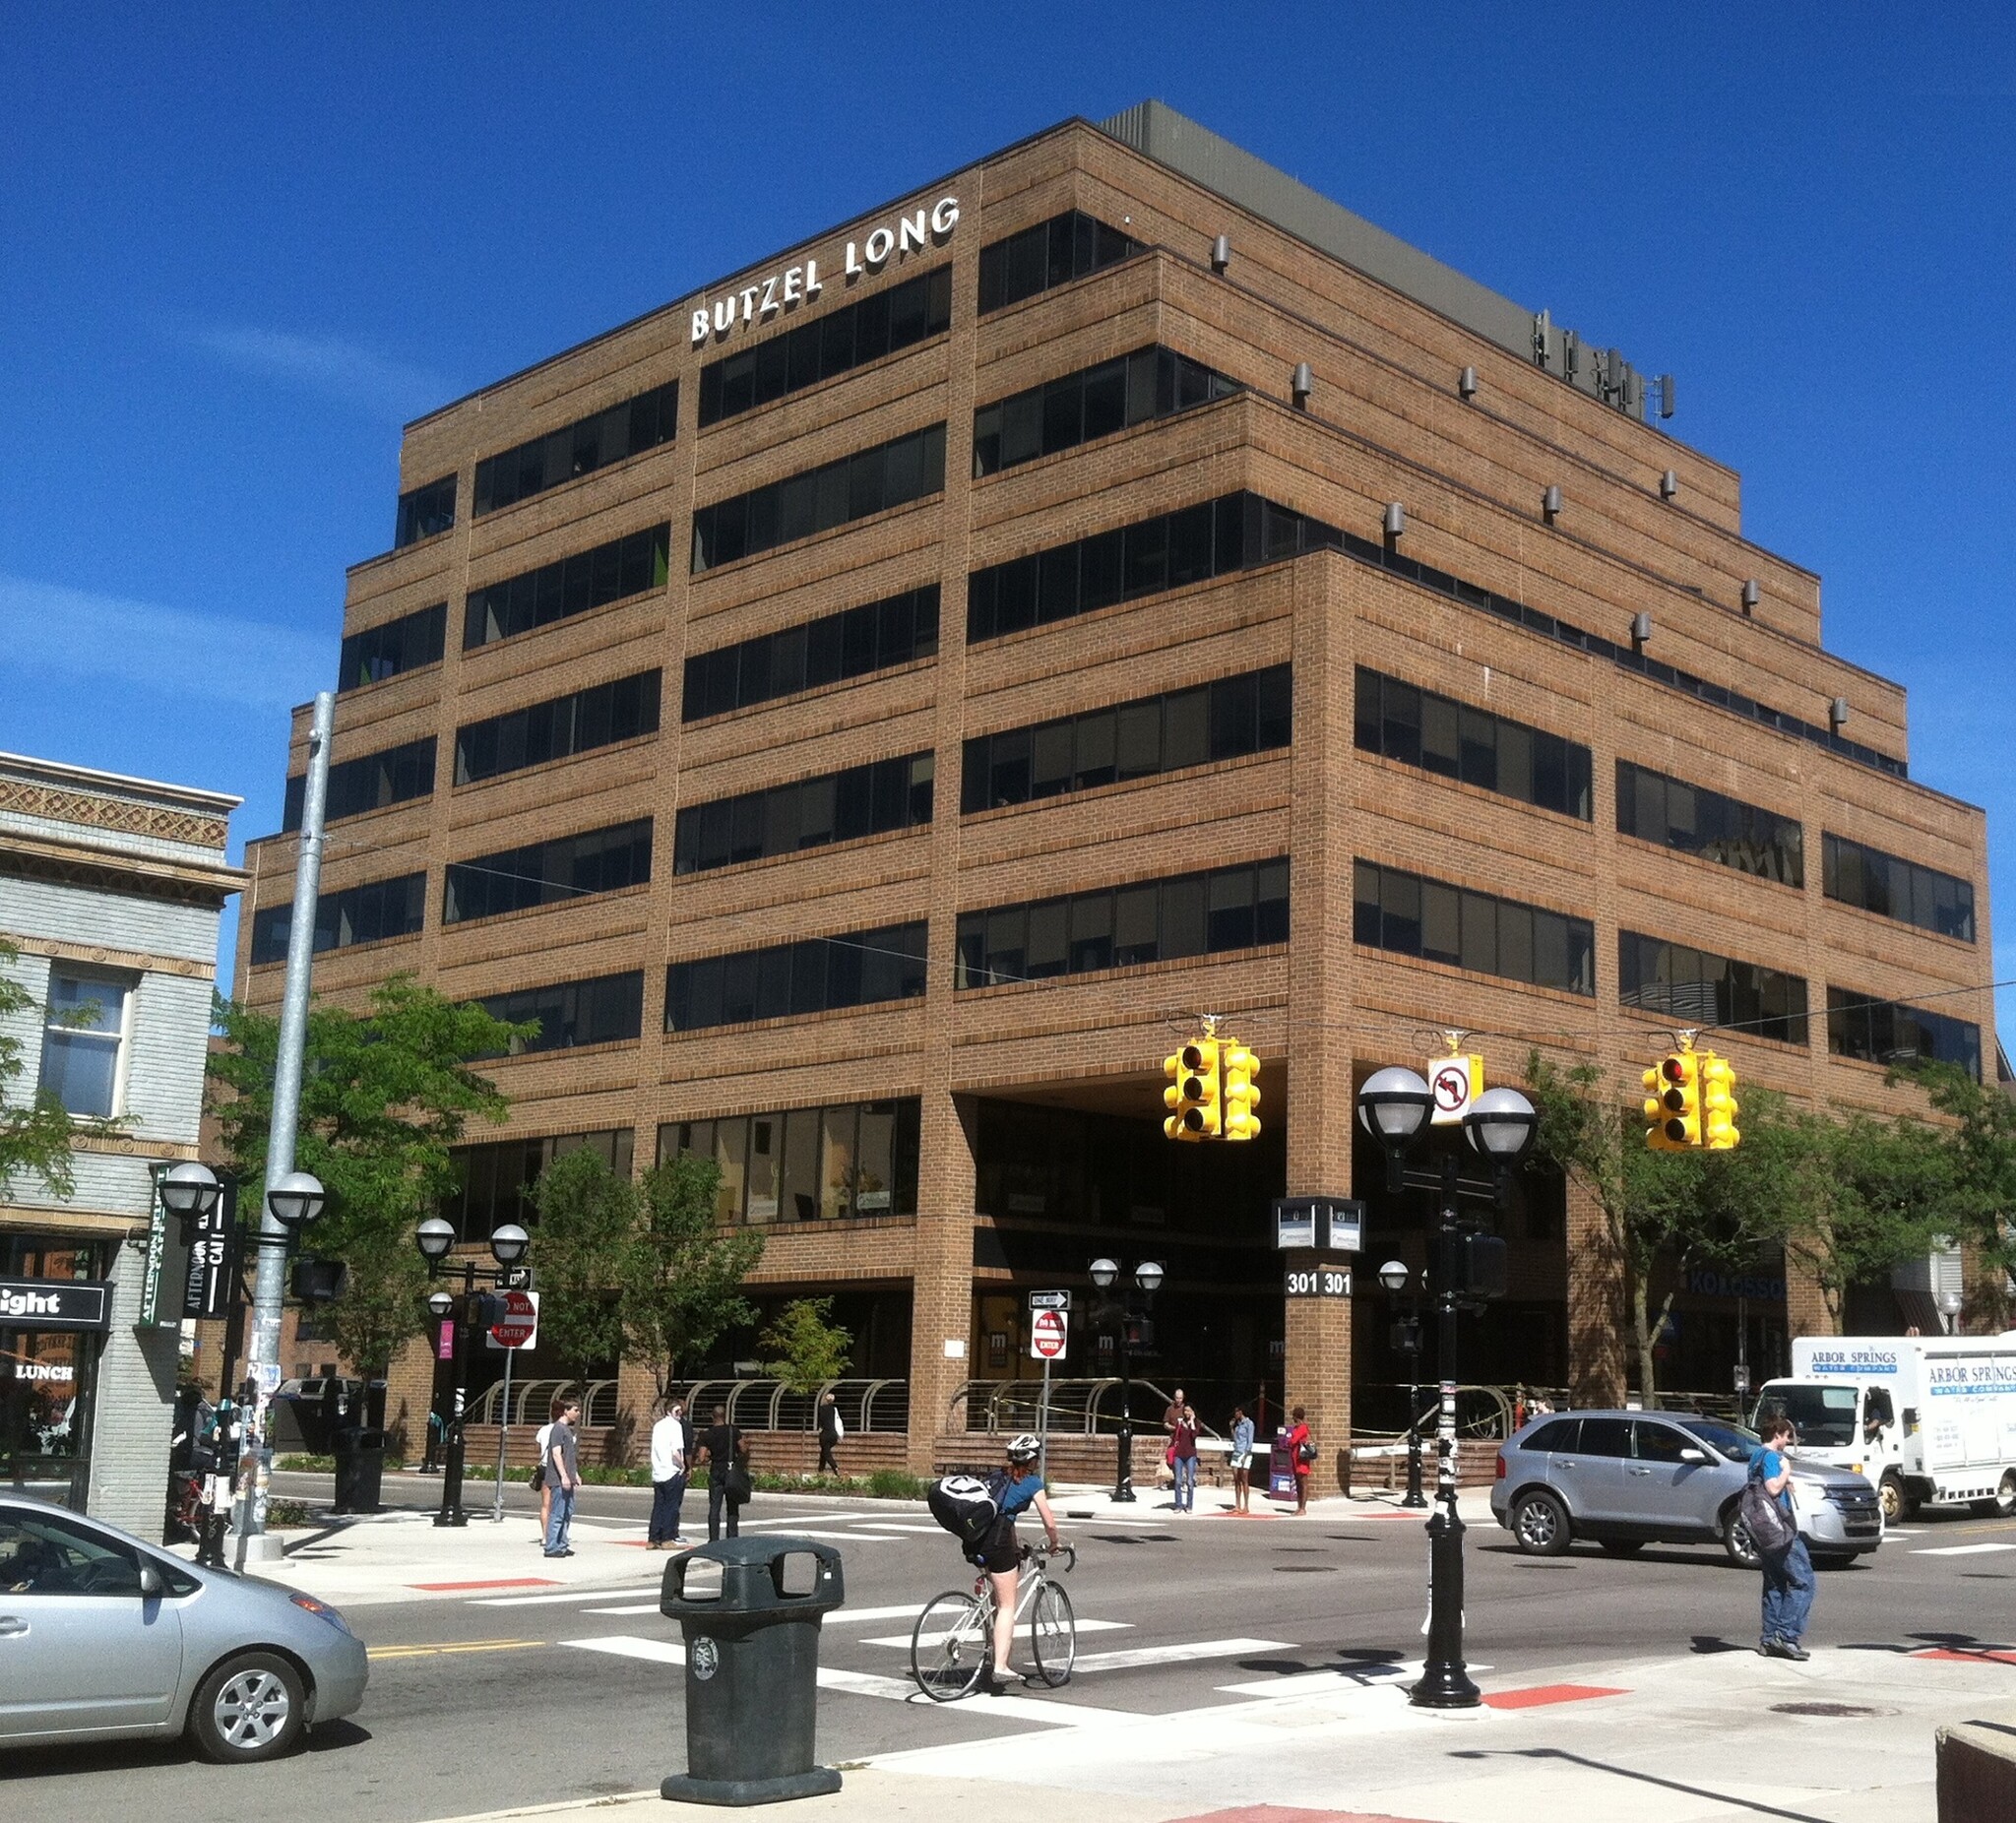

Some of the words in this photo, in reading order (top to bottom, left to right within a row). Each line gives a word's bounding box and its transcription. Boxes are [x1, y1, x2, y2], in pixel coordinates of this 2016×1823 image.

[691, 260, 823, 343] BUTZEL
[845, 197, 960, 275] LONG
[142, 1234, 159, 1320] AFTERNOON
[187, 1240, 207, 1309] AFTERNOON
[1288, 1273, 1318, 1292] 301
[1324, 1273, 1351, 1294] 301
[513, 1302, 531, 1311] NOT
[498, 1328, 526, 1338] ENTER
[1811, 1352, 1846, 1363] ARBOR
[1851, 1352, 1897, 1363] SPRINGS
[16, 1365, 74, 1381] LUNCH
[1929, 1366, 1969, 1383] ARBOR
